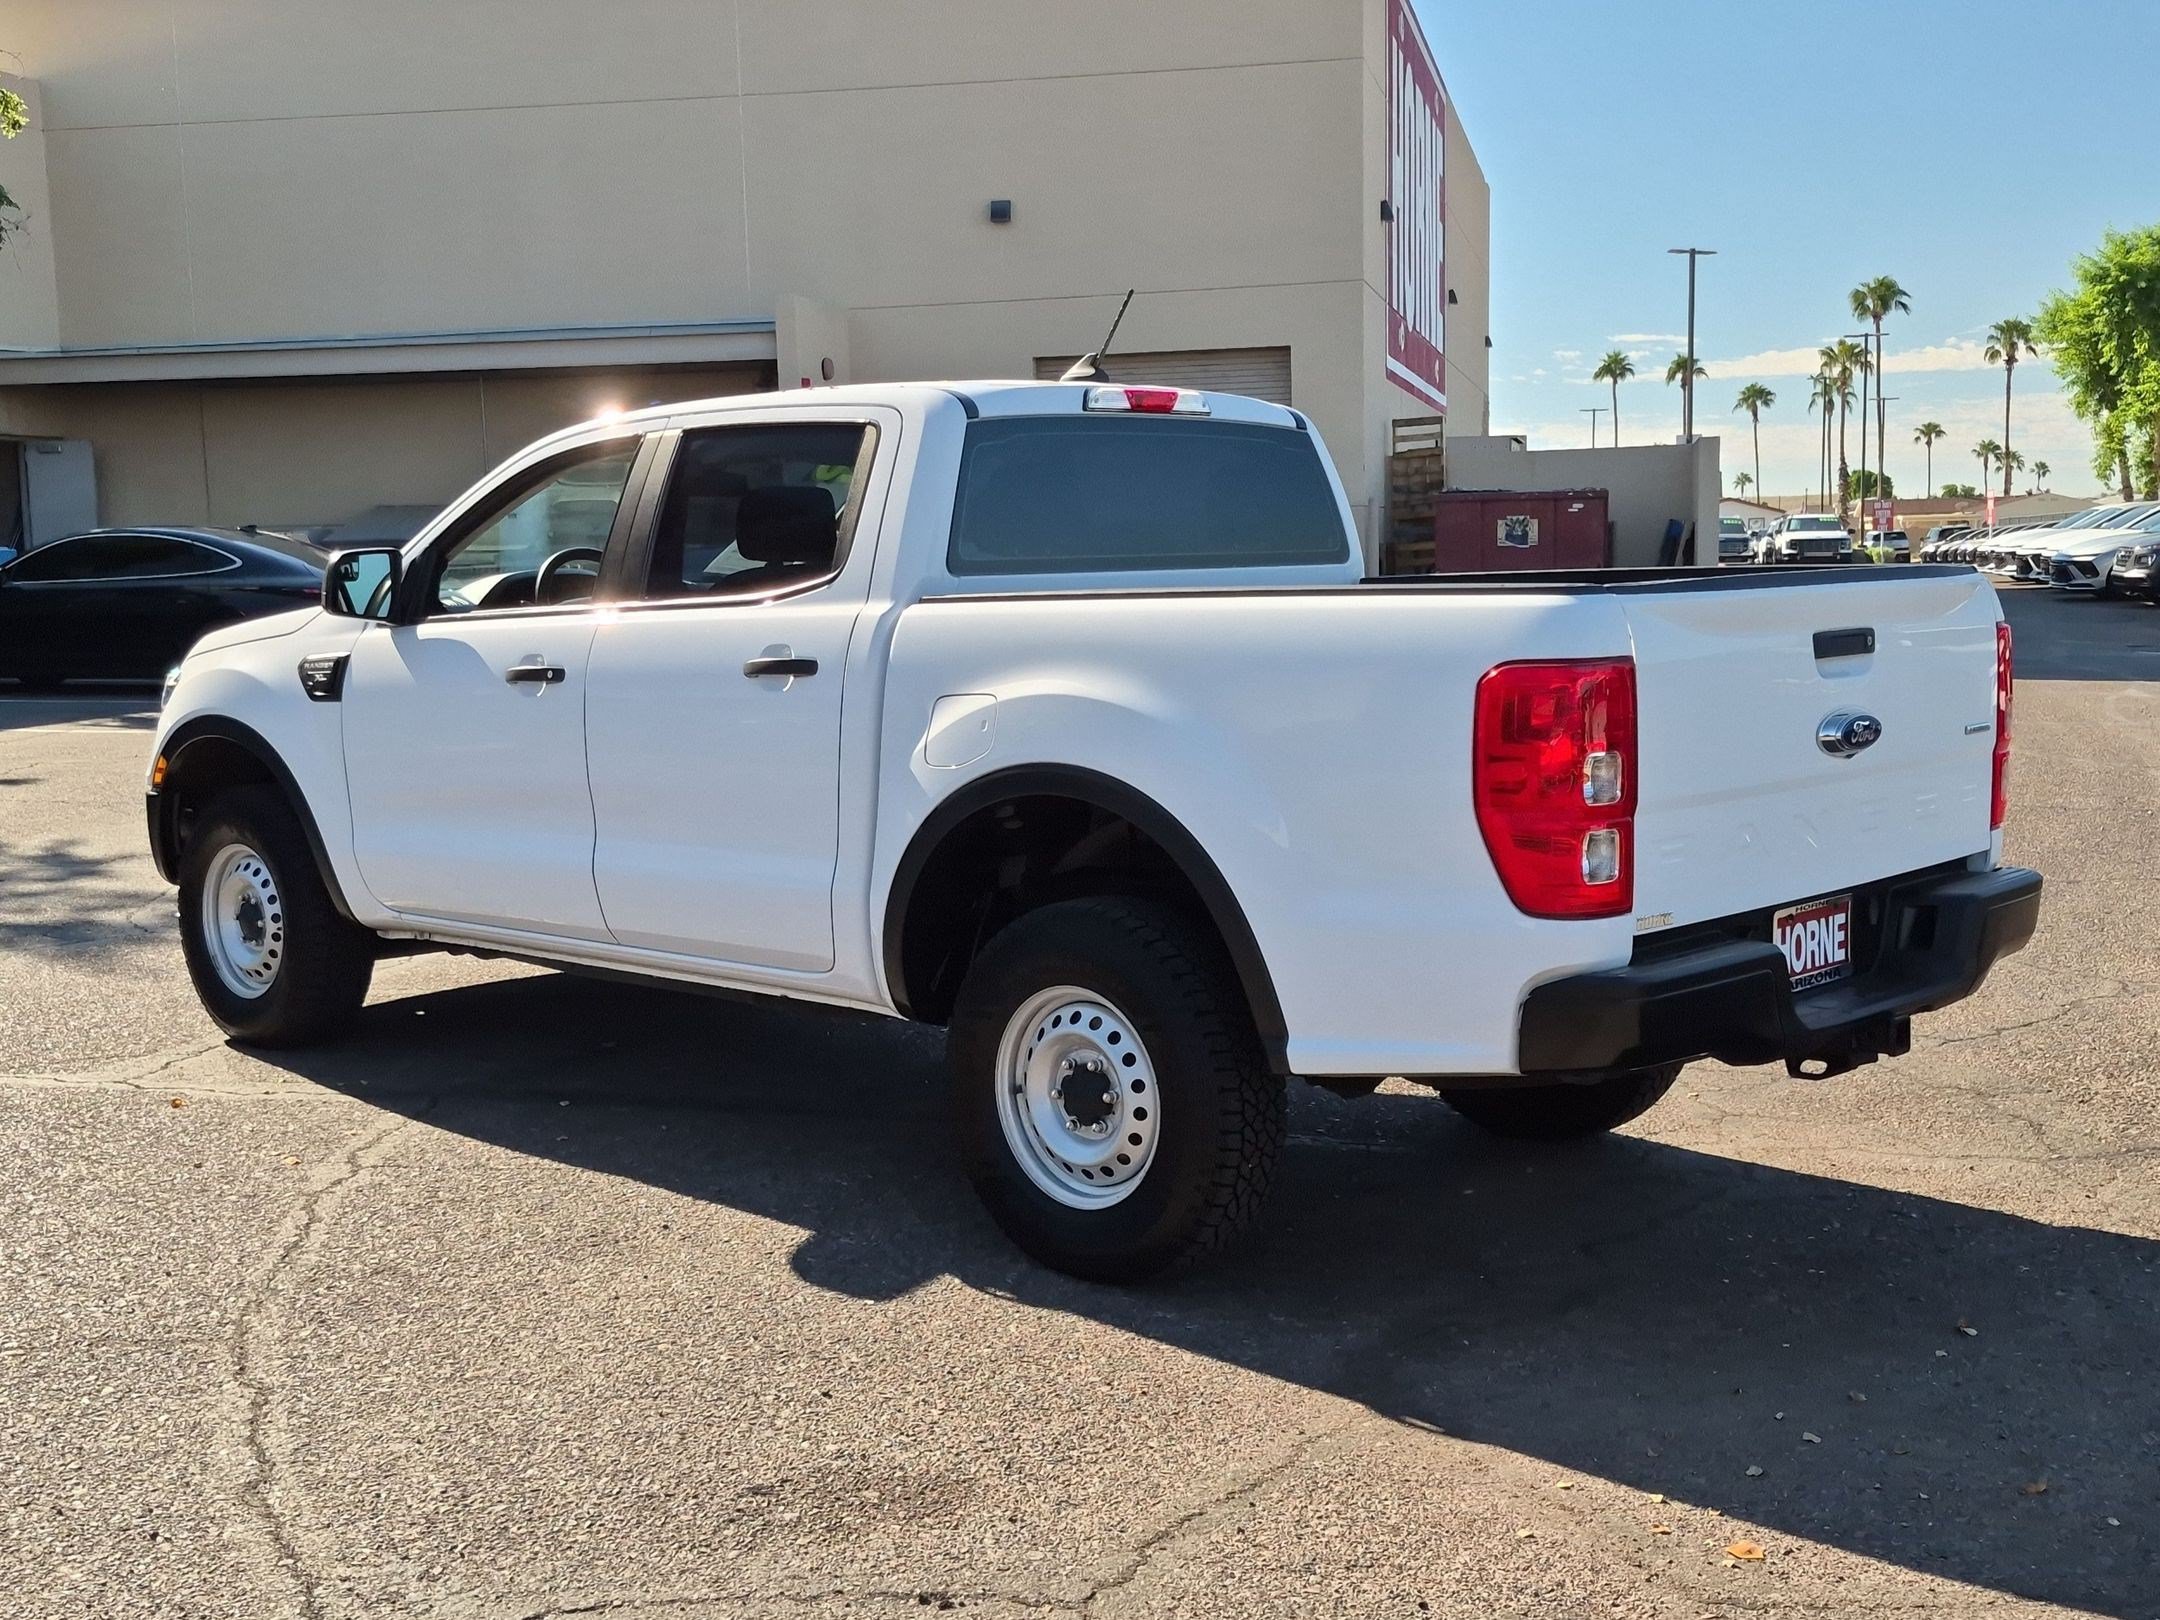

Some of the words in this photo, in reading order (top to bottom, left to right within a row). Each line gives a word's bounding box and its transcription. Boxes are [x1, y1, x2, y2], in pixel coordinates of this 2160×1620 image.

[1392, 35, 1444, 355] HORNE
[1851, 720, 1877, 744] Ford
[1777, 912, 1846, 974] HORNE
